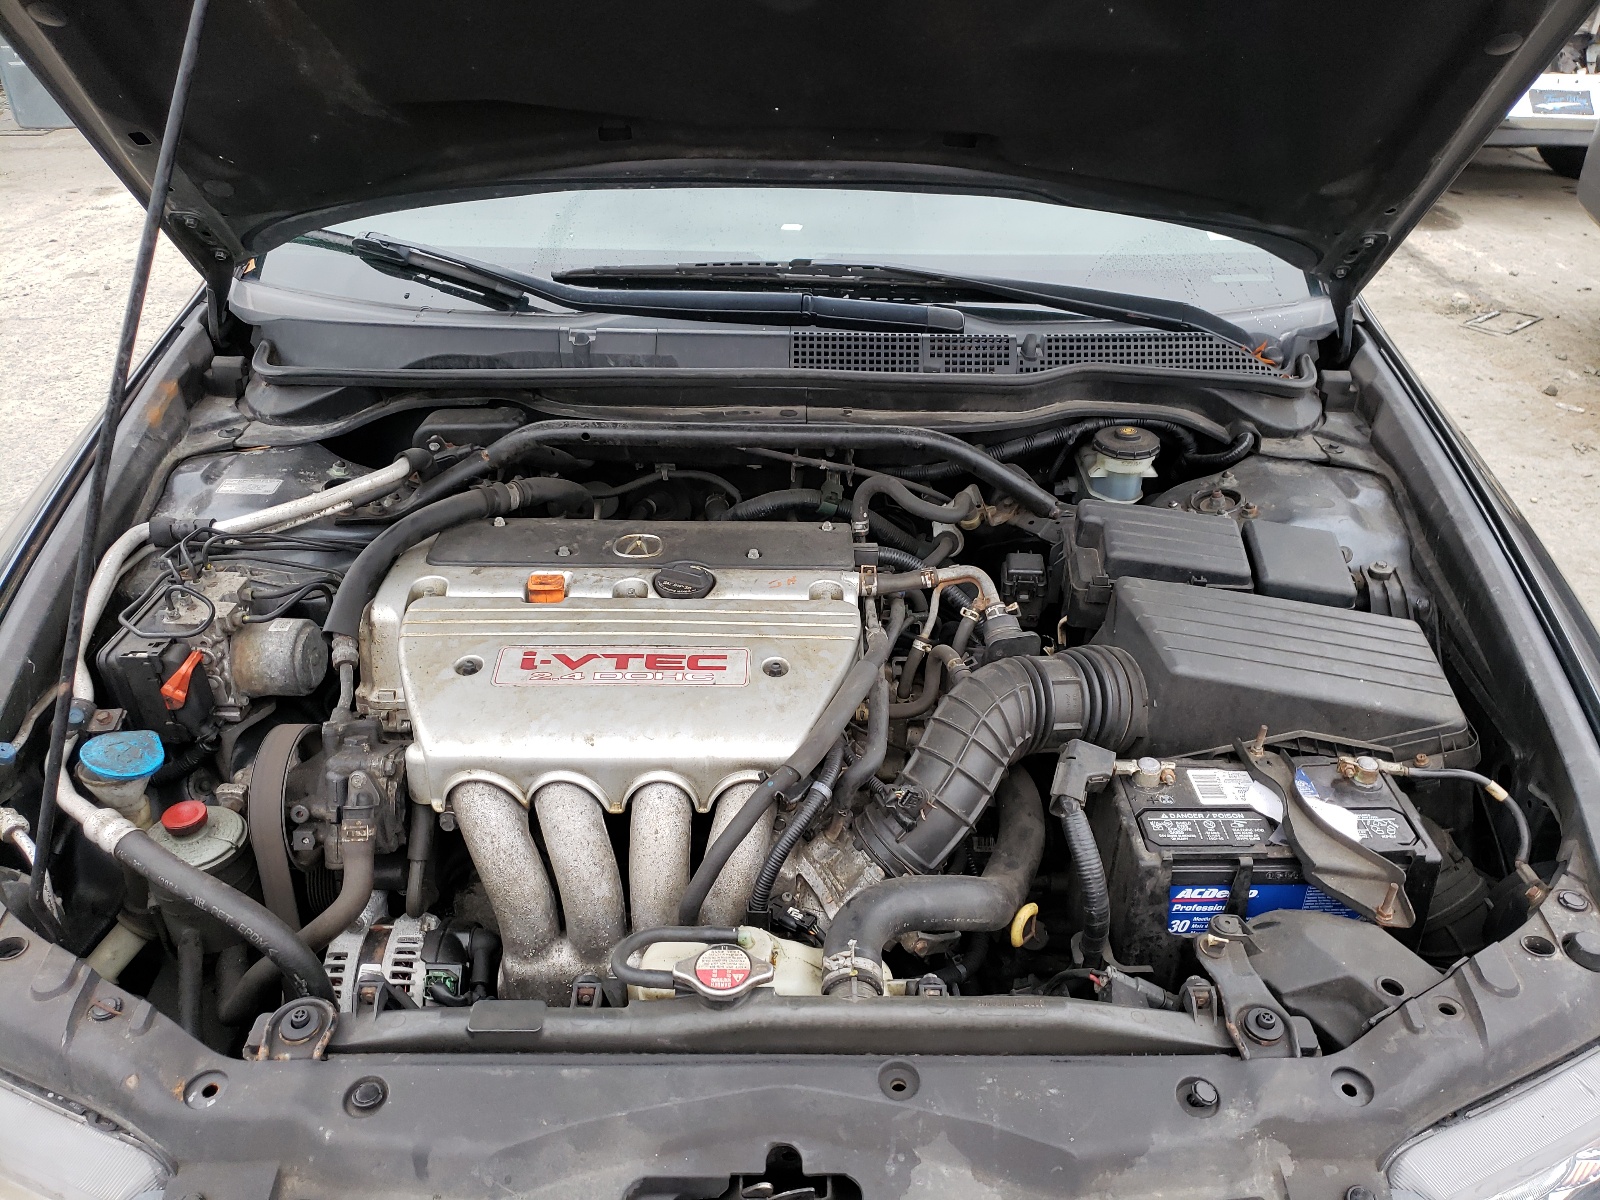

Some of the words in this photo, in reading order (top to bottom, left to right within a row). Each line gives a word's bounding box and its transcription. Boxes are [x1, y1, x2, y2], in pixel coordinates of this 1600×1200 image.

[520, 650, 728, 671] i-VTEC
[529, 672, 585, 681] 2.4
[593, 671, 715, 682] DOHC
[1175, 888, 1259, 899] ACDeo
[1172, 903, 1226, 912] Professio
[1168, 919, 1191, 933] 30
